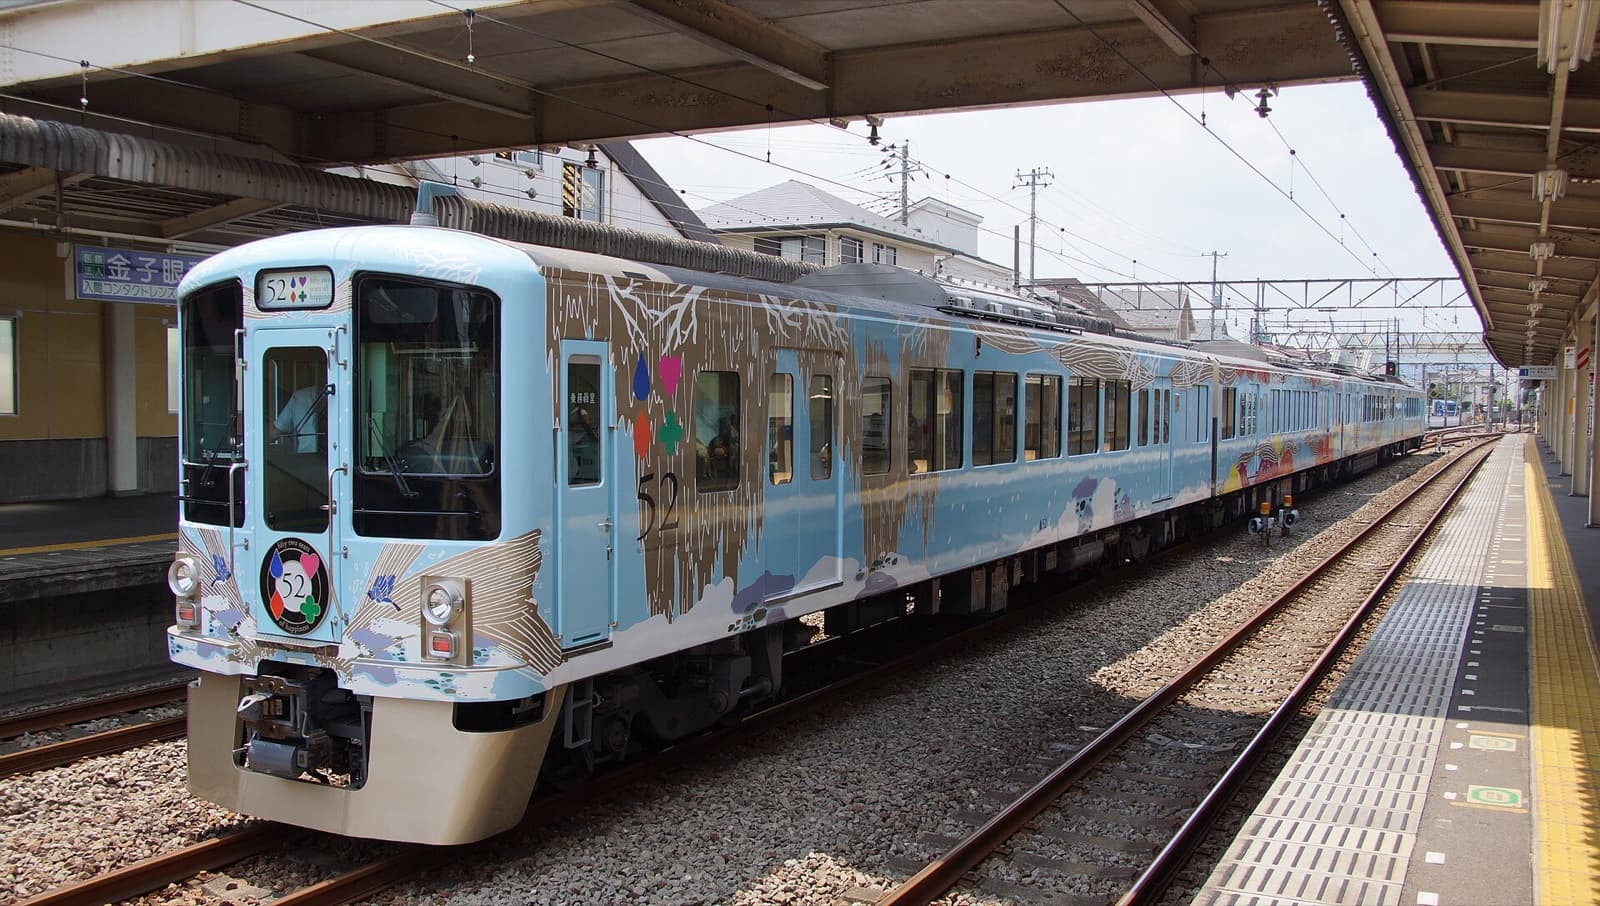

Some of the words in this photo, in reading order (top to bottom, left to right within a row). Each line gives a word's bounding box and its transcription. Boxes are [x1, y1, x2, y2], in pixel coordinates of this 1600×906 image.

[107, 254, 199, 284] 金子眼
[267, 279, 286, 303] 52
[637, 472, 680, 541] 52
[282, 573, 306, 598] 52
